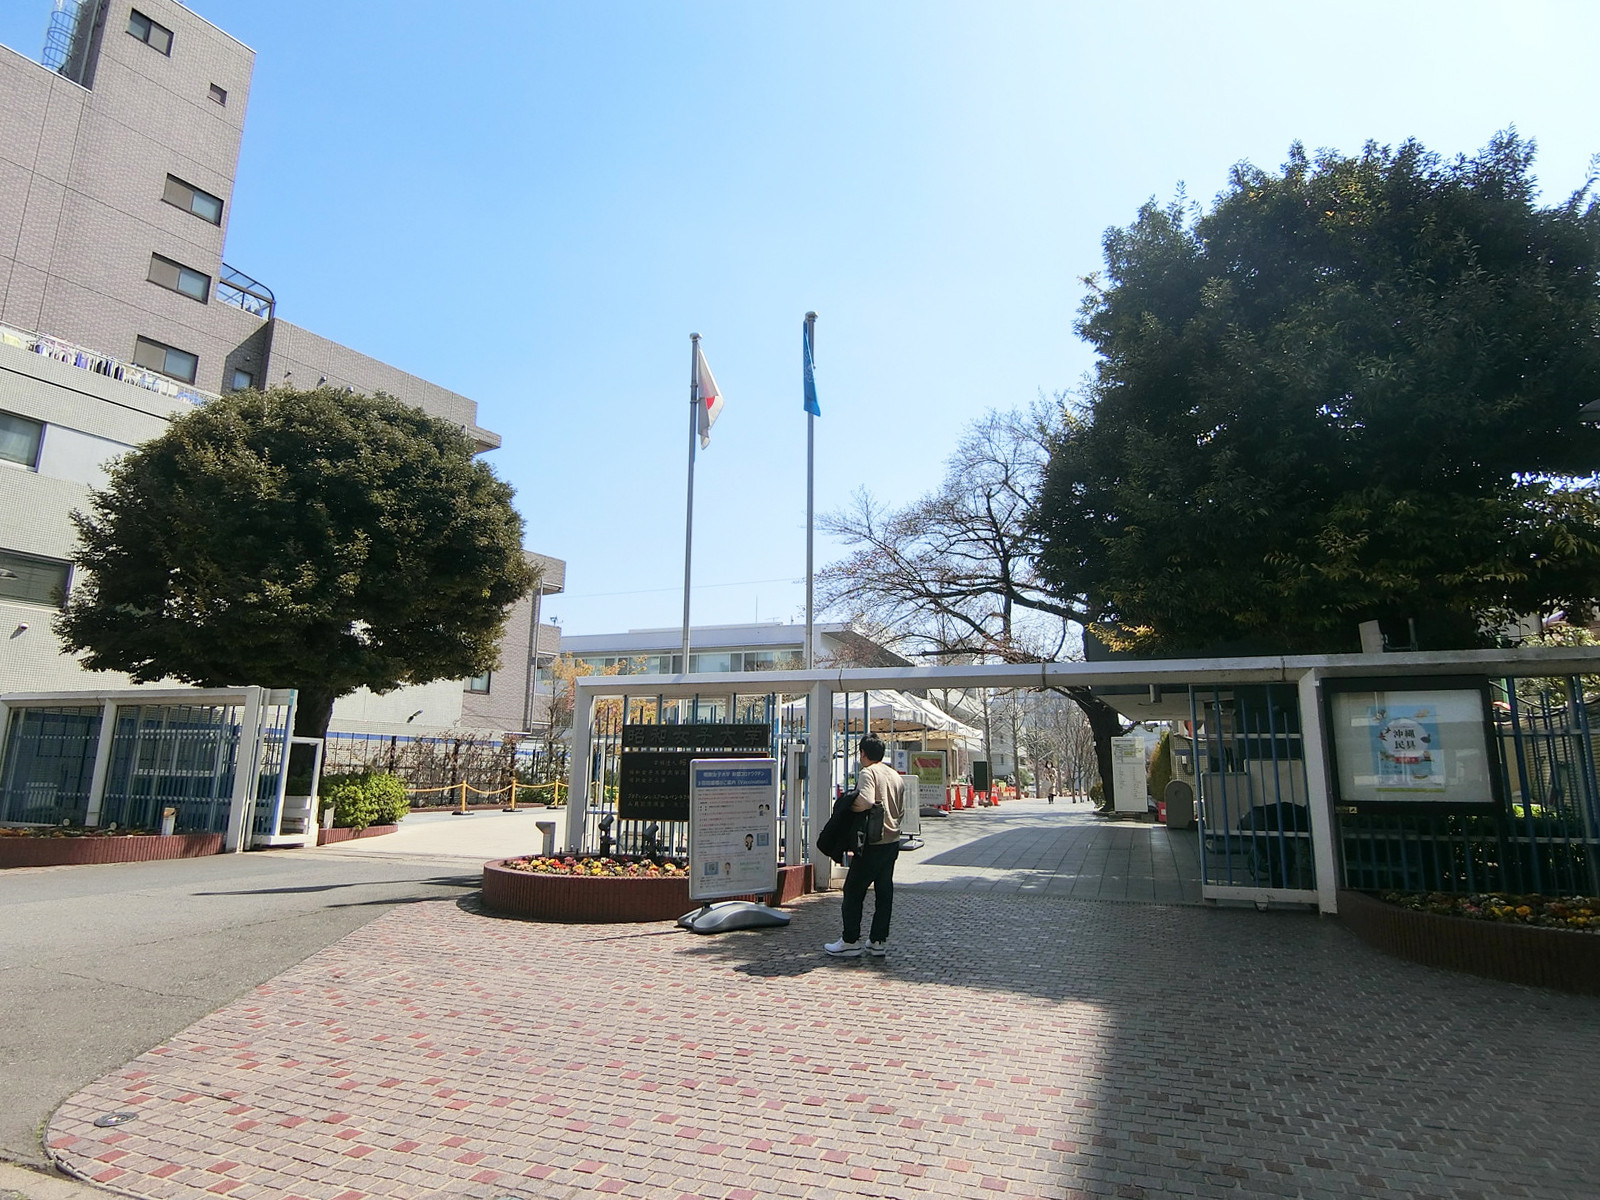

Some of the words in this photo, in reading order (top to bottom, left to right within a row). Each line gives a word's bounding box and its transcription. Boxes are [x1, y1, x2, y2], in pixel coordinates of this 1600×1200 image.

[628, 726, 762, 745] 昭和女子大学
[1393, 729, 1416, 739] 沖縄
[1394, 740, 1416, 750] 民具
